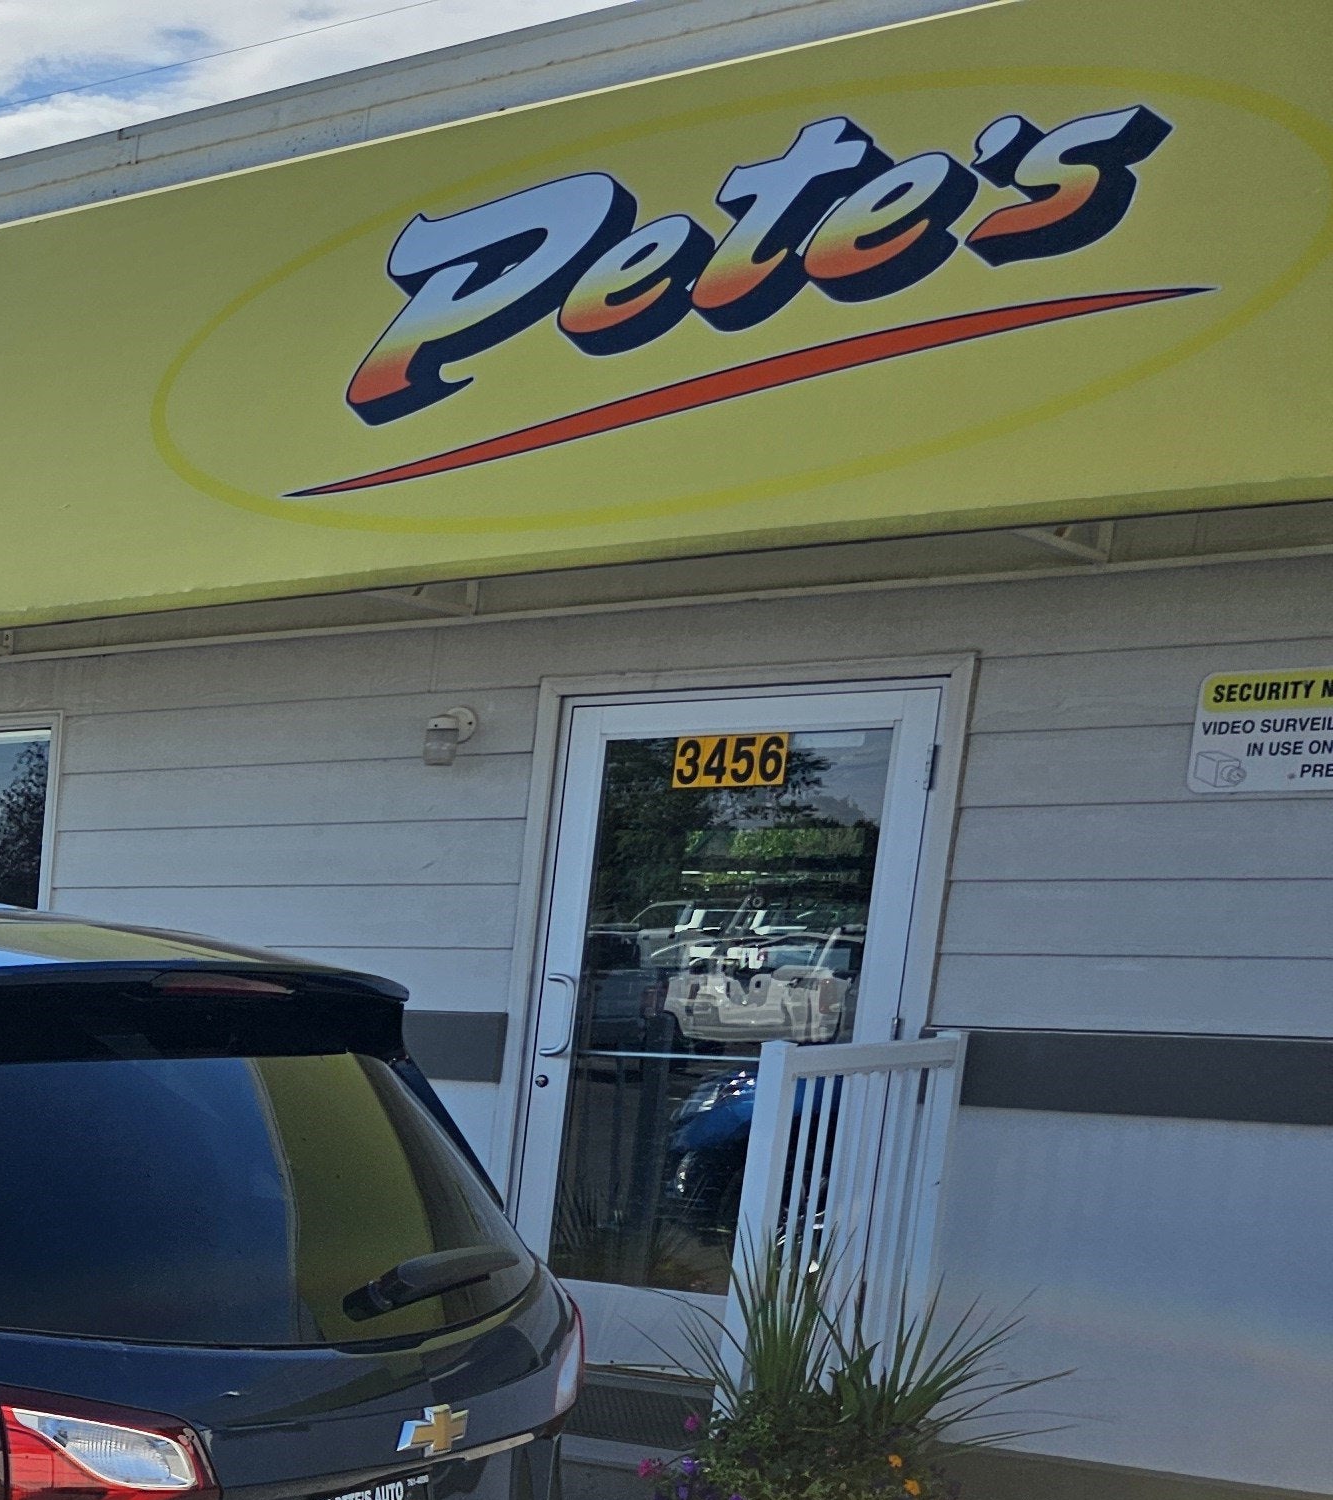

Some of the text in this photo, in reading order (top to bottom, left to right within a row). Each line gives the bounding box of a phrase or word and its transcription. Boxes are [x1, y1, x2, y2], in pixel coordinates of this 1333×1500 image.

[345, 104, 1175, 427] Pete's
[1212, 680, 1316, 703] SECURITY
[1202, 719, 1256, 736] VIDEO
[676, 736, 785, 785] 3456
[1246, 742, 1264, 757] IN
[1268, 741, 1303, 757] USE
